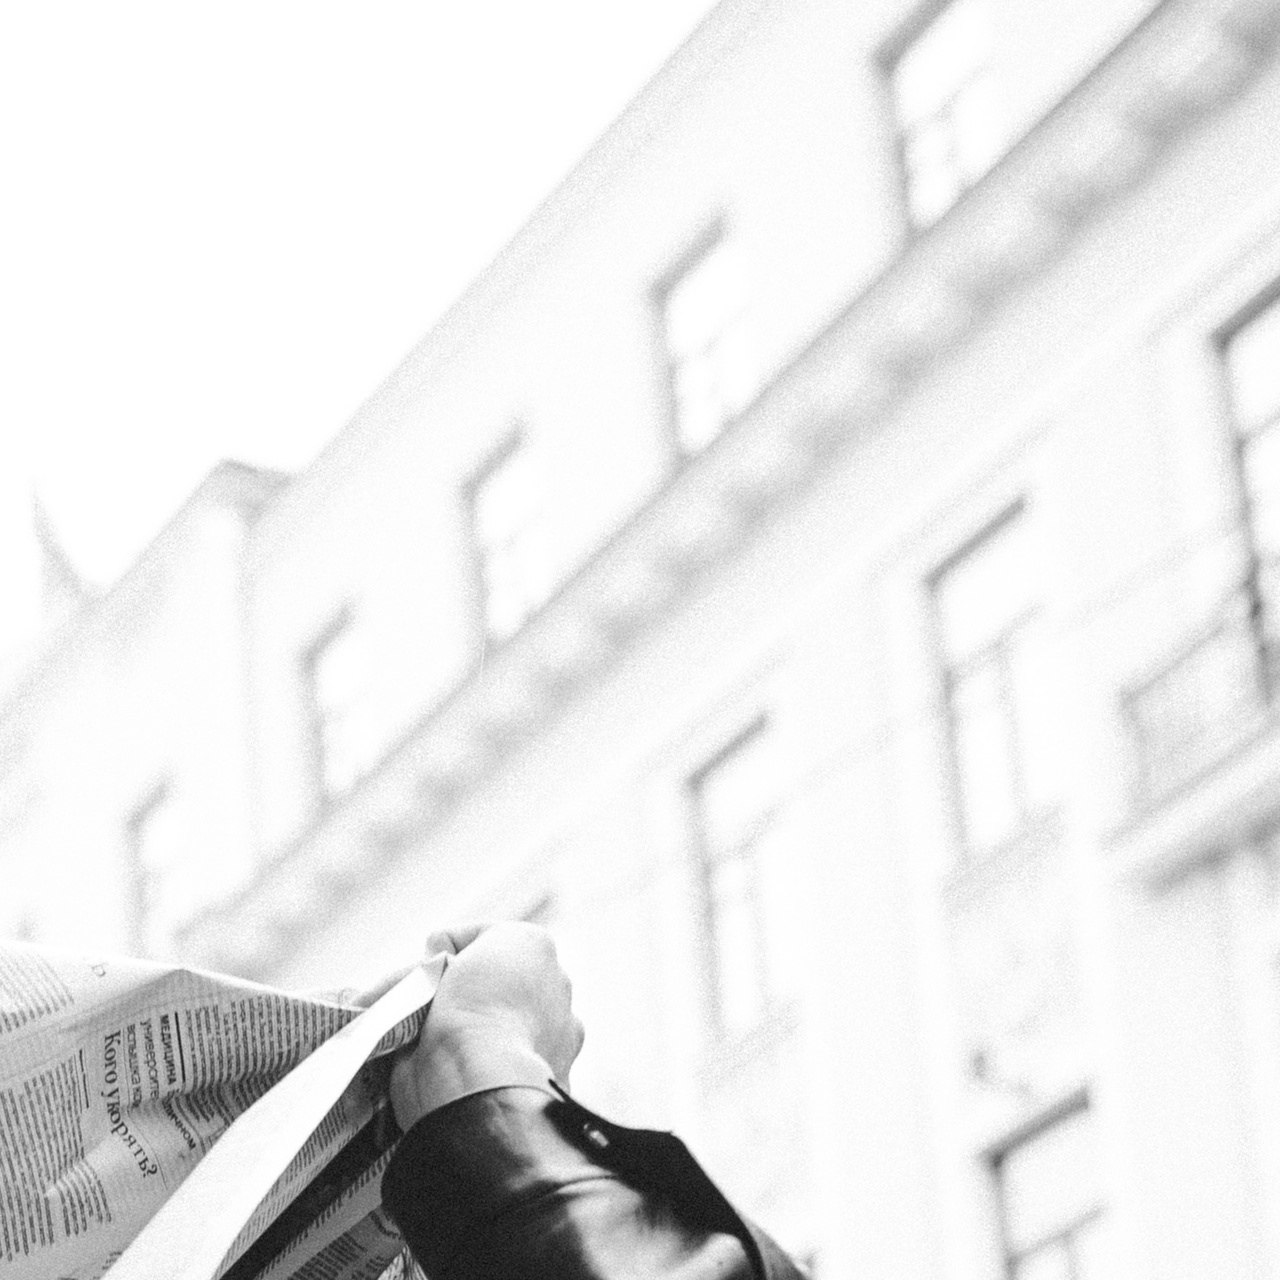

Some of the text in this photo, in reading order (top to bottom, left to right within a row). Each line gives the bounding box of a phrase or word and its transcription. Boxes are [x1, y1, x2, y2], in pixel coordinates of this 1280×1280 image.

[140, 1018, 160, 1100] университе
[160, 1014, 177, 1085] МЕДИЦИНА
[101, 1030, 158, 1178] Кого укорять?
